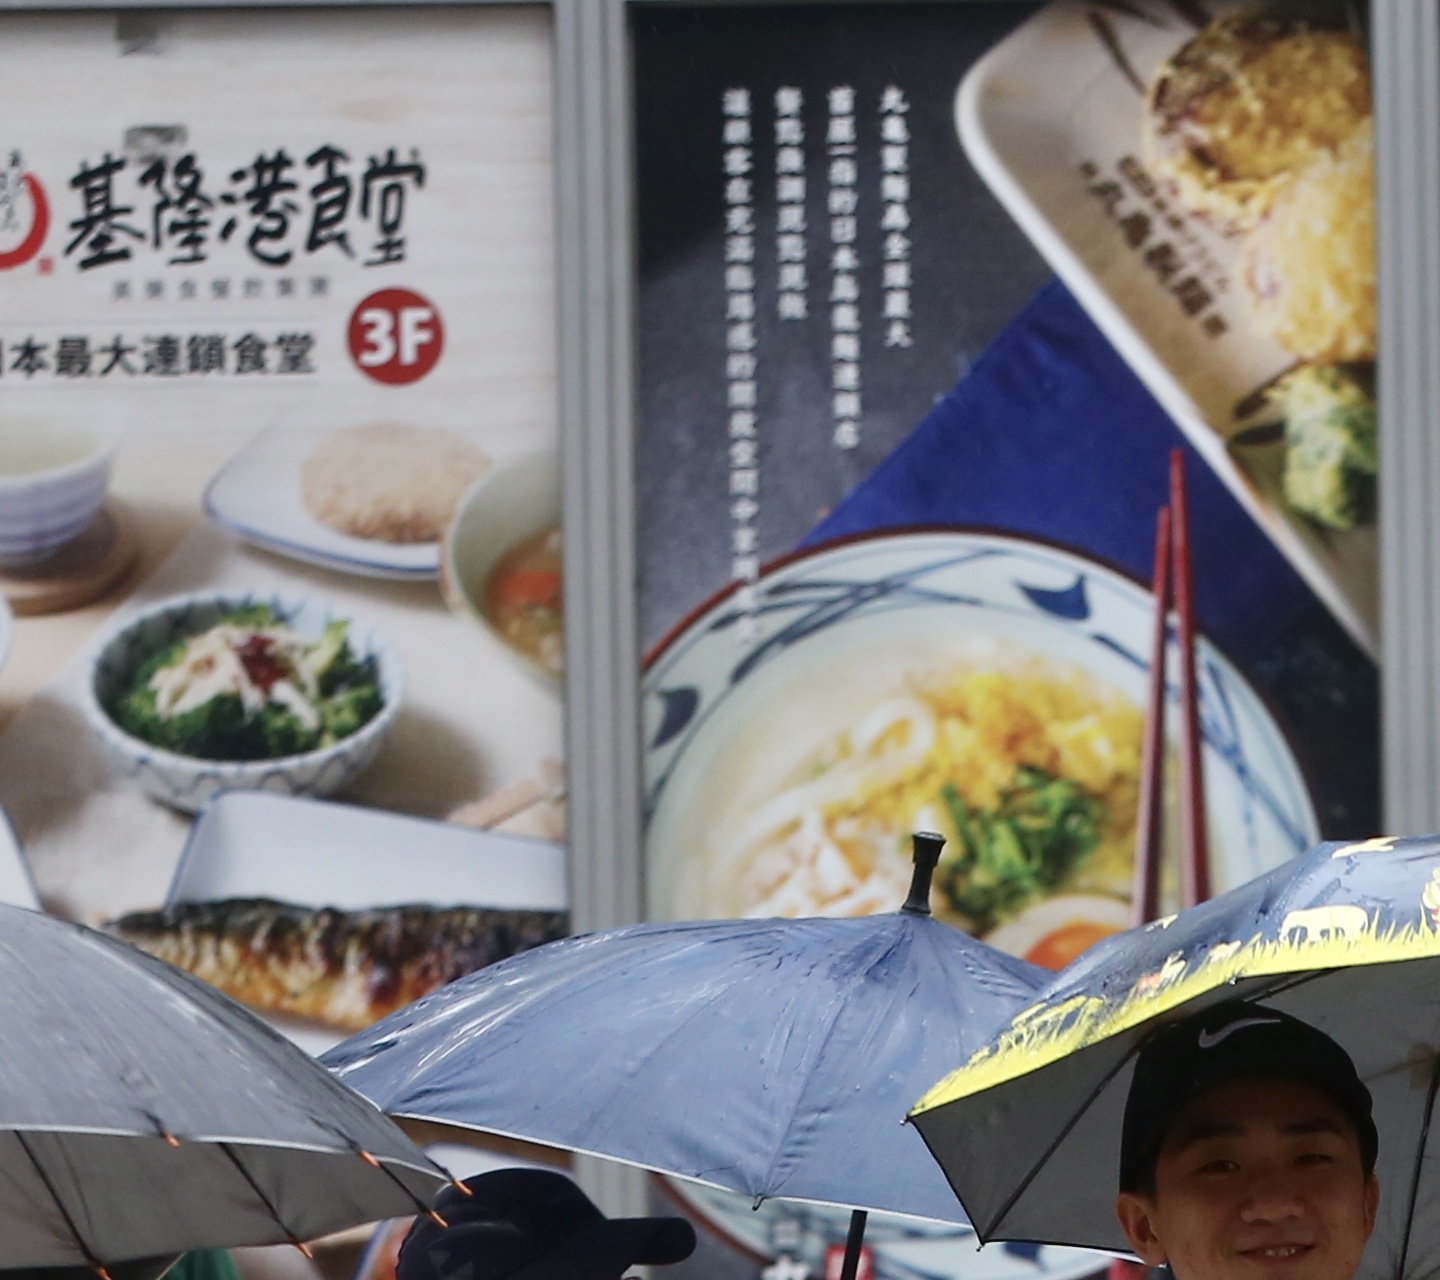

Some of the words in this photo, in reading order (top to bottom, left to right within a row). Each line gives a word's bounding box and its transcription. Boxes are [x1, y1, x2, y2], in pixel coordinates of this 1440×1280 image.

[64, 144, 426, 271] 基隆港食堂
[359, 307, 433, 367] 3F
